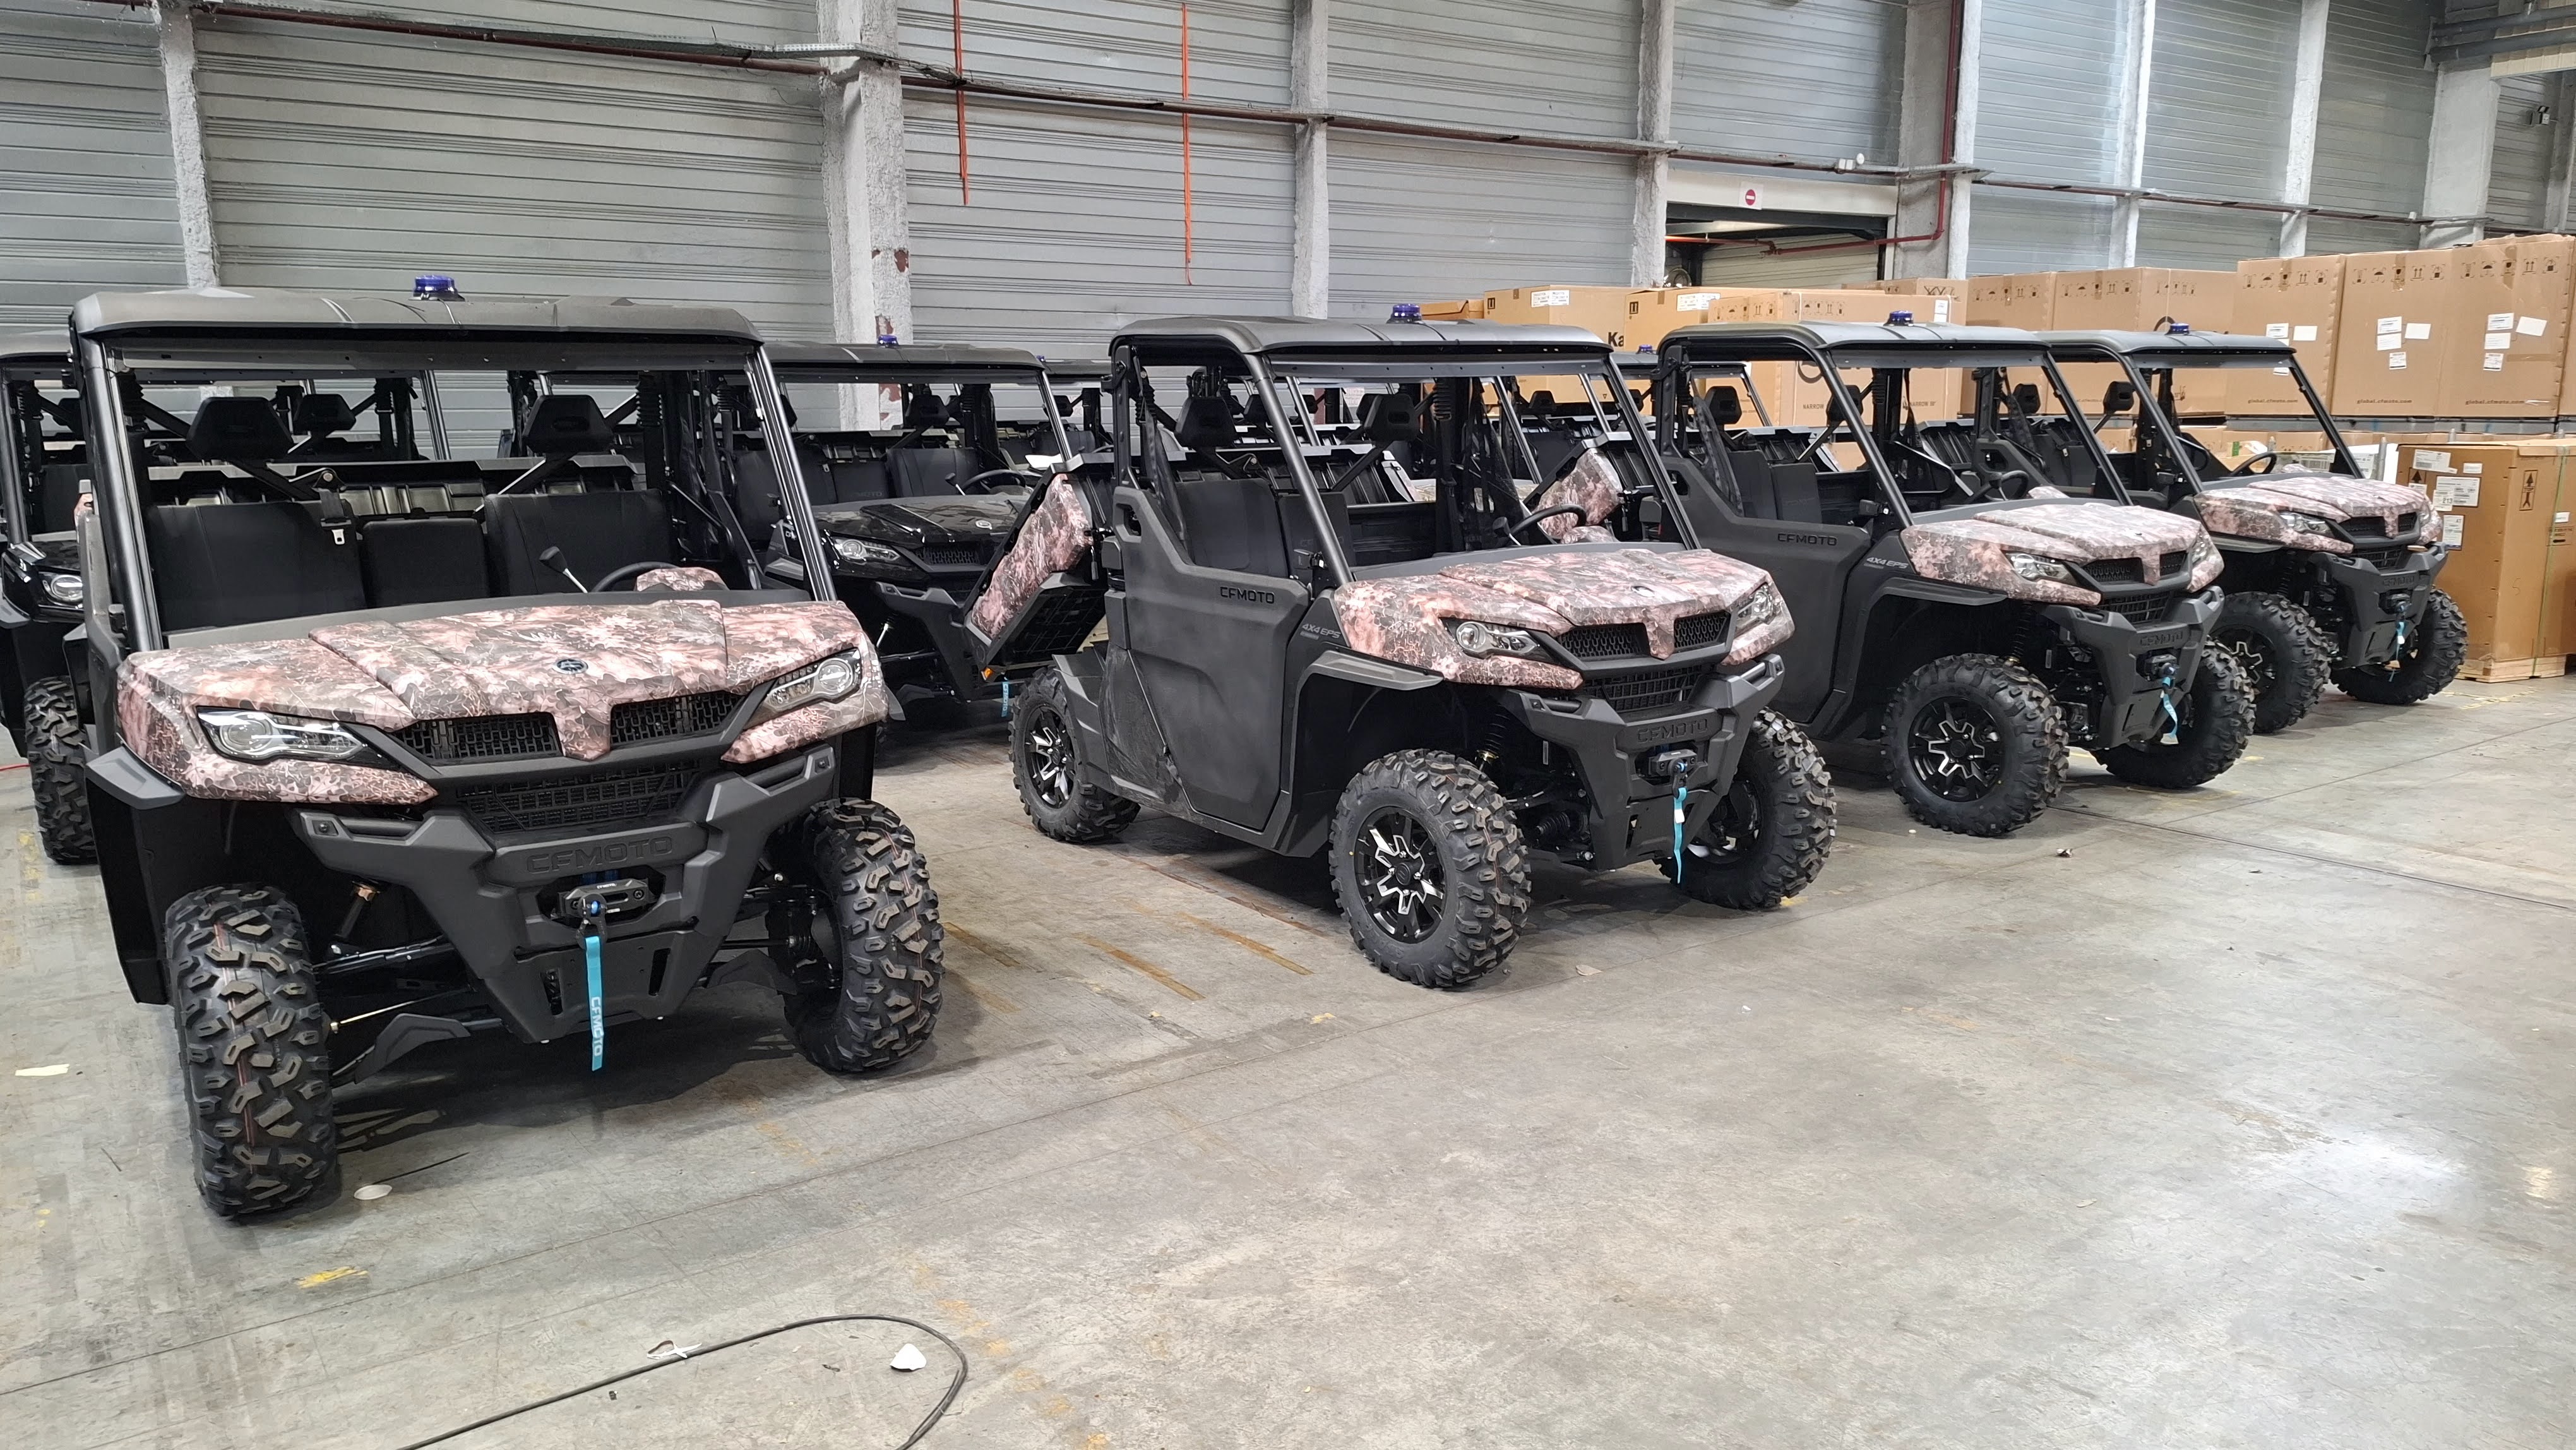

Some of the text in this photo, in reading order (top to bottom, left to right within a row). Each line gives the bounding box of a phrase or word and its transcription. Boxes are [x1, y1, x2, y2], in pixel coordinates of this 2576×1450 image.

[1777, 533, 1838, 546] CFMOTO
[1220, 586, 1275, 604] CFMOTO
[1637, 717, 1708, 744] CFMOTO
[527, 836, 672, 875] CFMOTO
[591, 997, 604, 1057] CFMOTO
